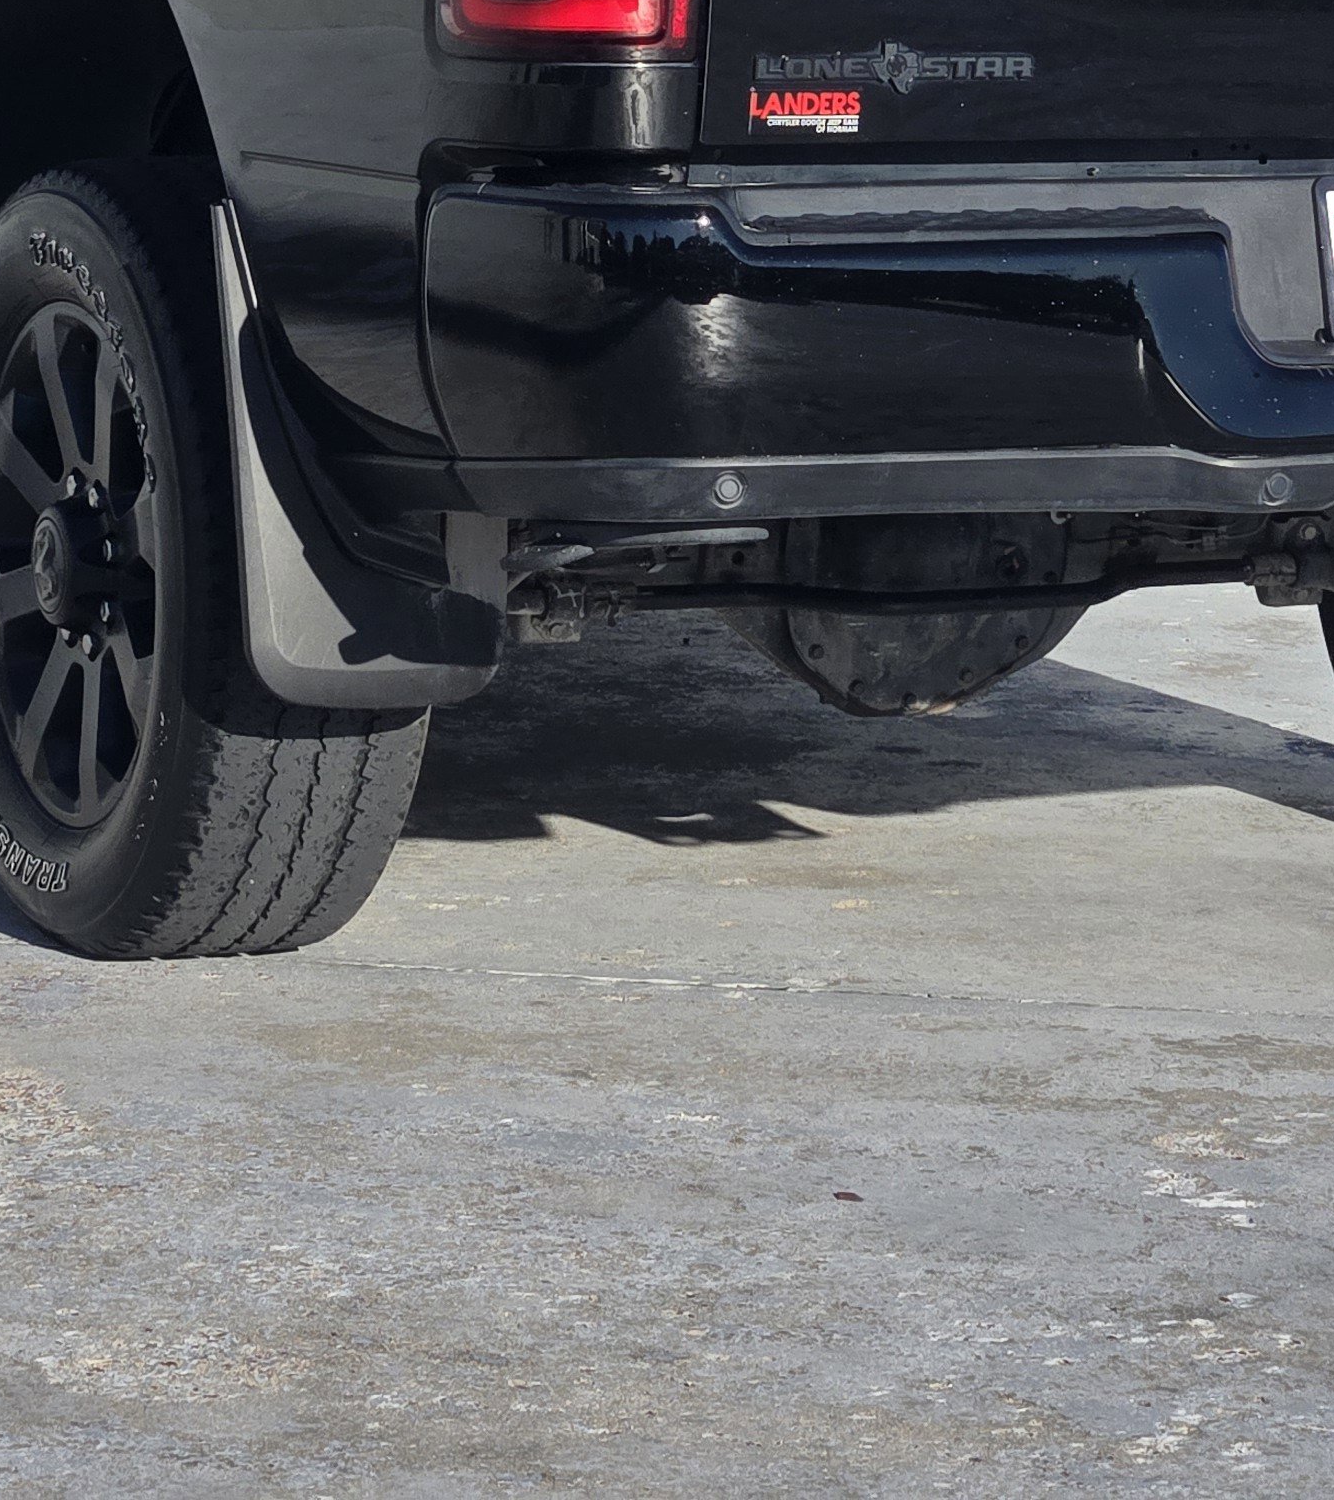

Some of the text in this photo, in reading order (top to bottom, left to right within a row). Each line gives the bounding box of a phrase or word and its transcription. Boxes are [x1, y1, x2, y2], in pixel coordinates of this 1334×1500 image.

[754, 55, 1034, 80] LONE STAR
[751, 91, 861, 119] LANDERS
